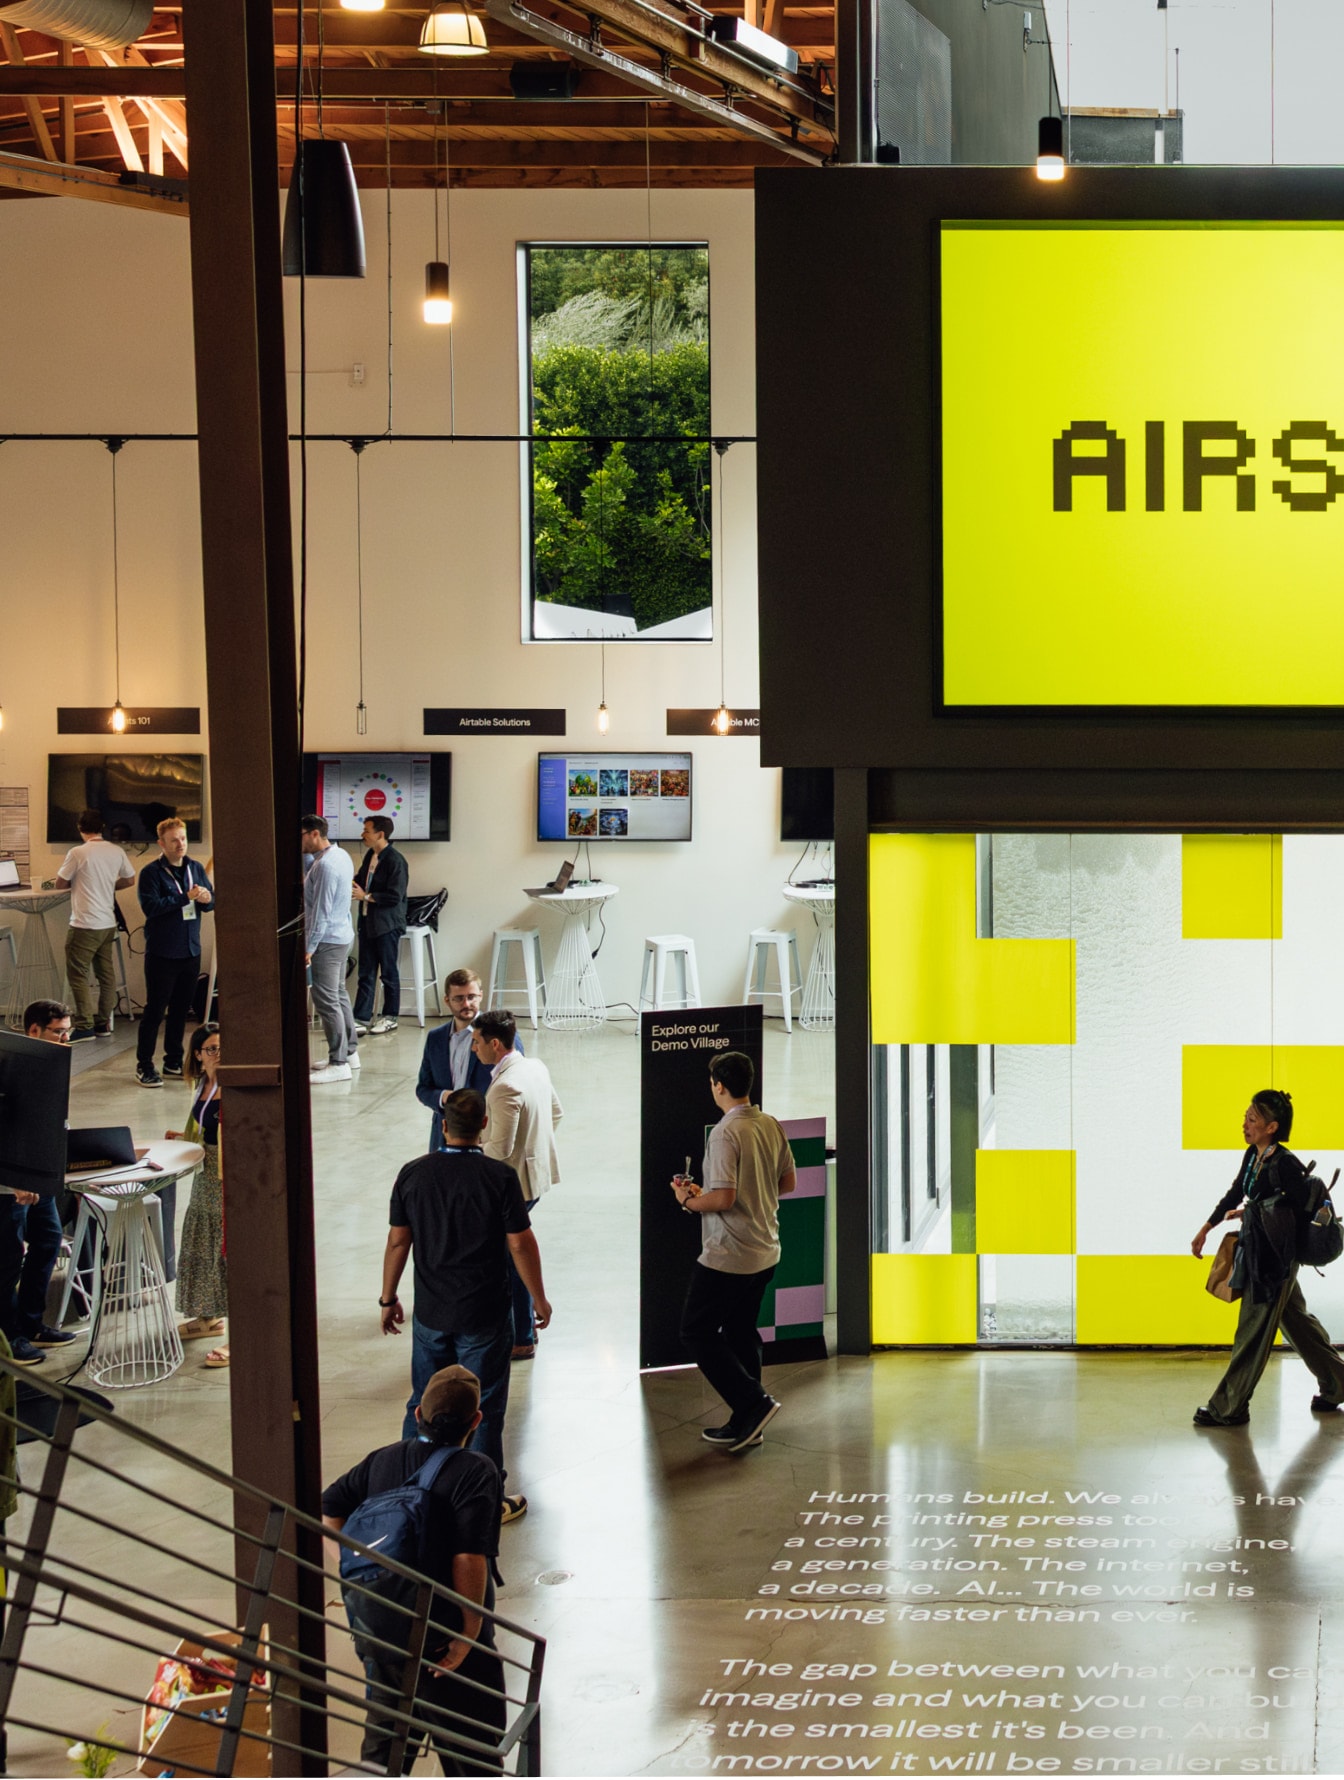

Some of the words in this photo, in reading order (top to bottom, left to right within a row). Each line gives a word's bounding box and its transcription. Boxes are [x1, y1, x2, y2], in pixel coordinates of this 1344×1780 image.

[138, 716, 150, 725] 101
[459, 718, 492, 727] Airtable
[493, 718, 531, 727] Solutions
[651, 1023, 697, 1038] Explore
[698, 1023, 720, 1034] our
[651, 1040, 689, 1052] Demo
[690, 1036, 730, 1050] Village
[808, 1490, 955, 1504] Humans
[963, 1490, 1055, 1504] build.
[1064, 1491, 1122, 1505] We
[800, 1511, 865, 1525] The
[1016, 1514, 1113, 1528] press
[1121, 1513, 1198, 1527] too
[783, 1536, 805, 1548] a
[968, 1534, 1036, 1548] The
[1044, 1535, 1156, 1549] steam
[770, 1559, 794, 1571] a
[799, 1557, 1008, 1574] generation.
[1018, 1557, 1088, 1571] The
[1096, 1557, 1250, 1575] internet,
[757, 1583, 781, 1595] a
[789, 1580, 941, 1596] decade.
[1032, 1581, 1103, 1597] The
[1111, 1582, 1218, 1598] world
[1227, 1582, 1256, 1598] is
[744, 1605, 889, 1625] moving
[896, 1605, 1009, 1622] faster
[1014, 1606, 1101, 1623] than
[1110, 1609, 1199, 1624] ever.
[719, 1658, 794, 1677] The
[799, 1661, 878, 1681] gap
[887, 1659, 1066, 1679] between
[1075, 1661, 1179, 1679] what
[1184, 1664, 1256, 1682] you
[699, 1688, 864, 1710] imagine
[872, 1689, 953, 1707] and
[960, 1689, 1065, 1708] what
[1068, 1694, 1147, 1713] you
[684, 1718, 717, 1738] is
[726, 1719, 796, 1738] the
[804, 1719, 983, 1738] smallest
[991, 1720, 1047, 1739] it's
[1057, 1720, 1173, 1740] been.
[1183, 1721, 1271, 1740] And
[670, 1753, 883, 1771] tomorrow
[890, 1751, 920, 1771] it
[928, 1751, 996, 1771] will
[1006, 1752, 1062, 1772] be
[1071, 1752, 1231, 1772] smaller
